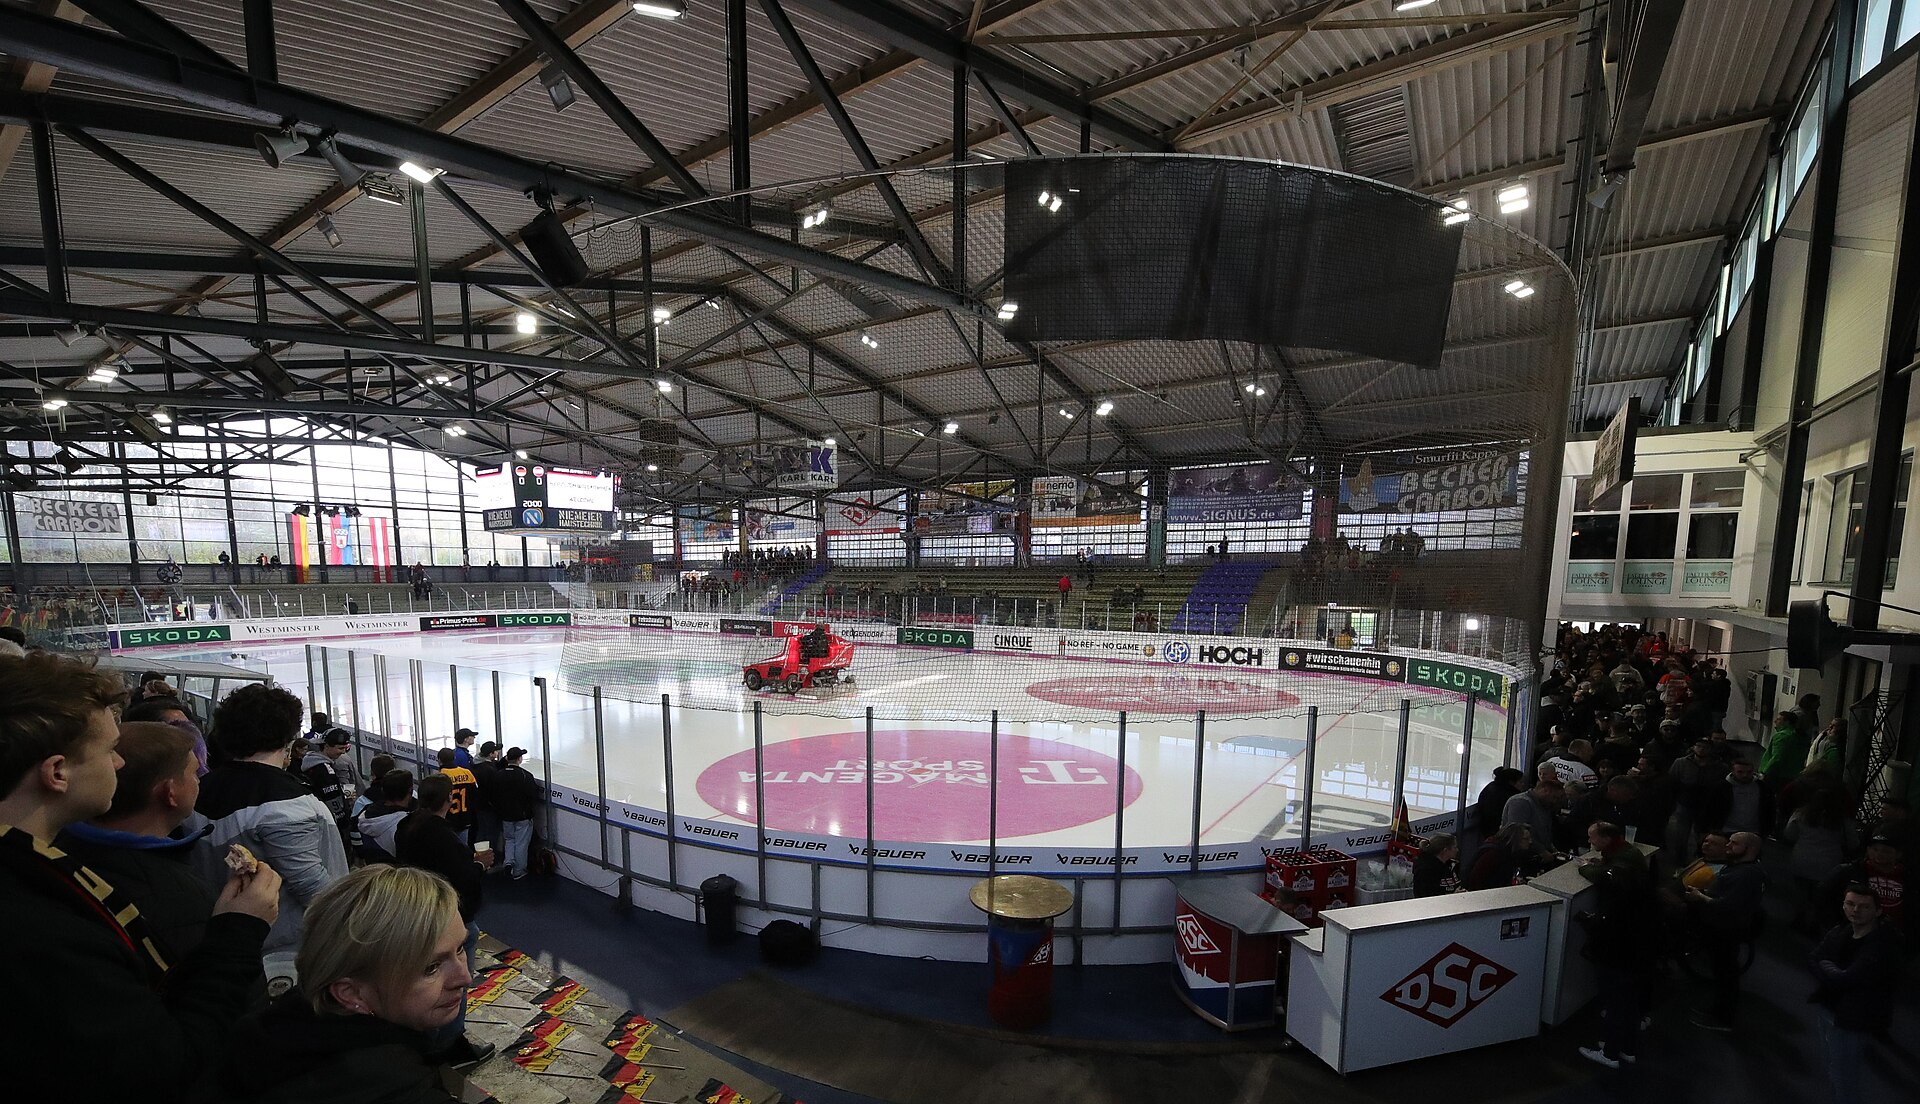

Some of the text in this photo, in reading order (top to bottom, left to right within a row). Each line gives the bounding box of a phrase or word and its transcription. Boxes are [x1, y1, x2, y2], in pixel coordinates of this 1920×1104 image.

[1415, 450, 1498, 464] Smurfit Kappa
[519, 477, 542, 485] 0 0
[811, 473, 835, 484] KARL
[1400, 455, 1508, 493] BECKER
[1397, 481, 1502, 512] CARBON
[31, 498, 118, 518] BECKER
[1170, 508, 1275, 522] www.SIGNUS.de
[558, 510, 602, 521] NIEMEIER
[35, 514, 122, 533] CARBON
[1571, 577, 1608, 585] LOUNGE
[1626, 577, 1666, 586] LOUNGE
[1685, 576, 1728, 585] LOUNGE
[246, 624, 320, 635] WESTMINSTER
[345, 620, 408, 630] WESTMINSTER
[994, 634, 1033, 648] CINQUE
[1067, 640, 1078, 648] NO
[1116, 643, 1139, 651] GAME
[1199, 645, 1262, 666] HOCH
[1306, 652, 1381, 669] #wirschauenhin
[1355, 833, 1392, 847] BAUE
[1178, 919, 1210, 950] DSC
[1394, 953, 1498, 1020] DSC
